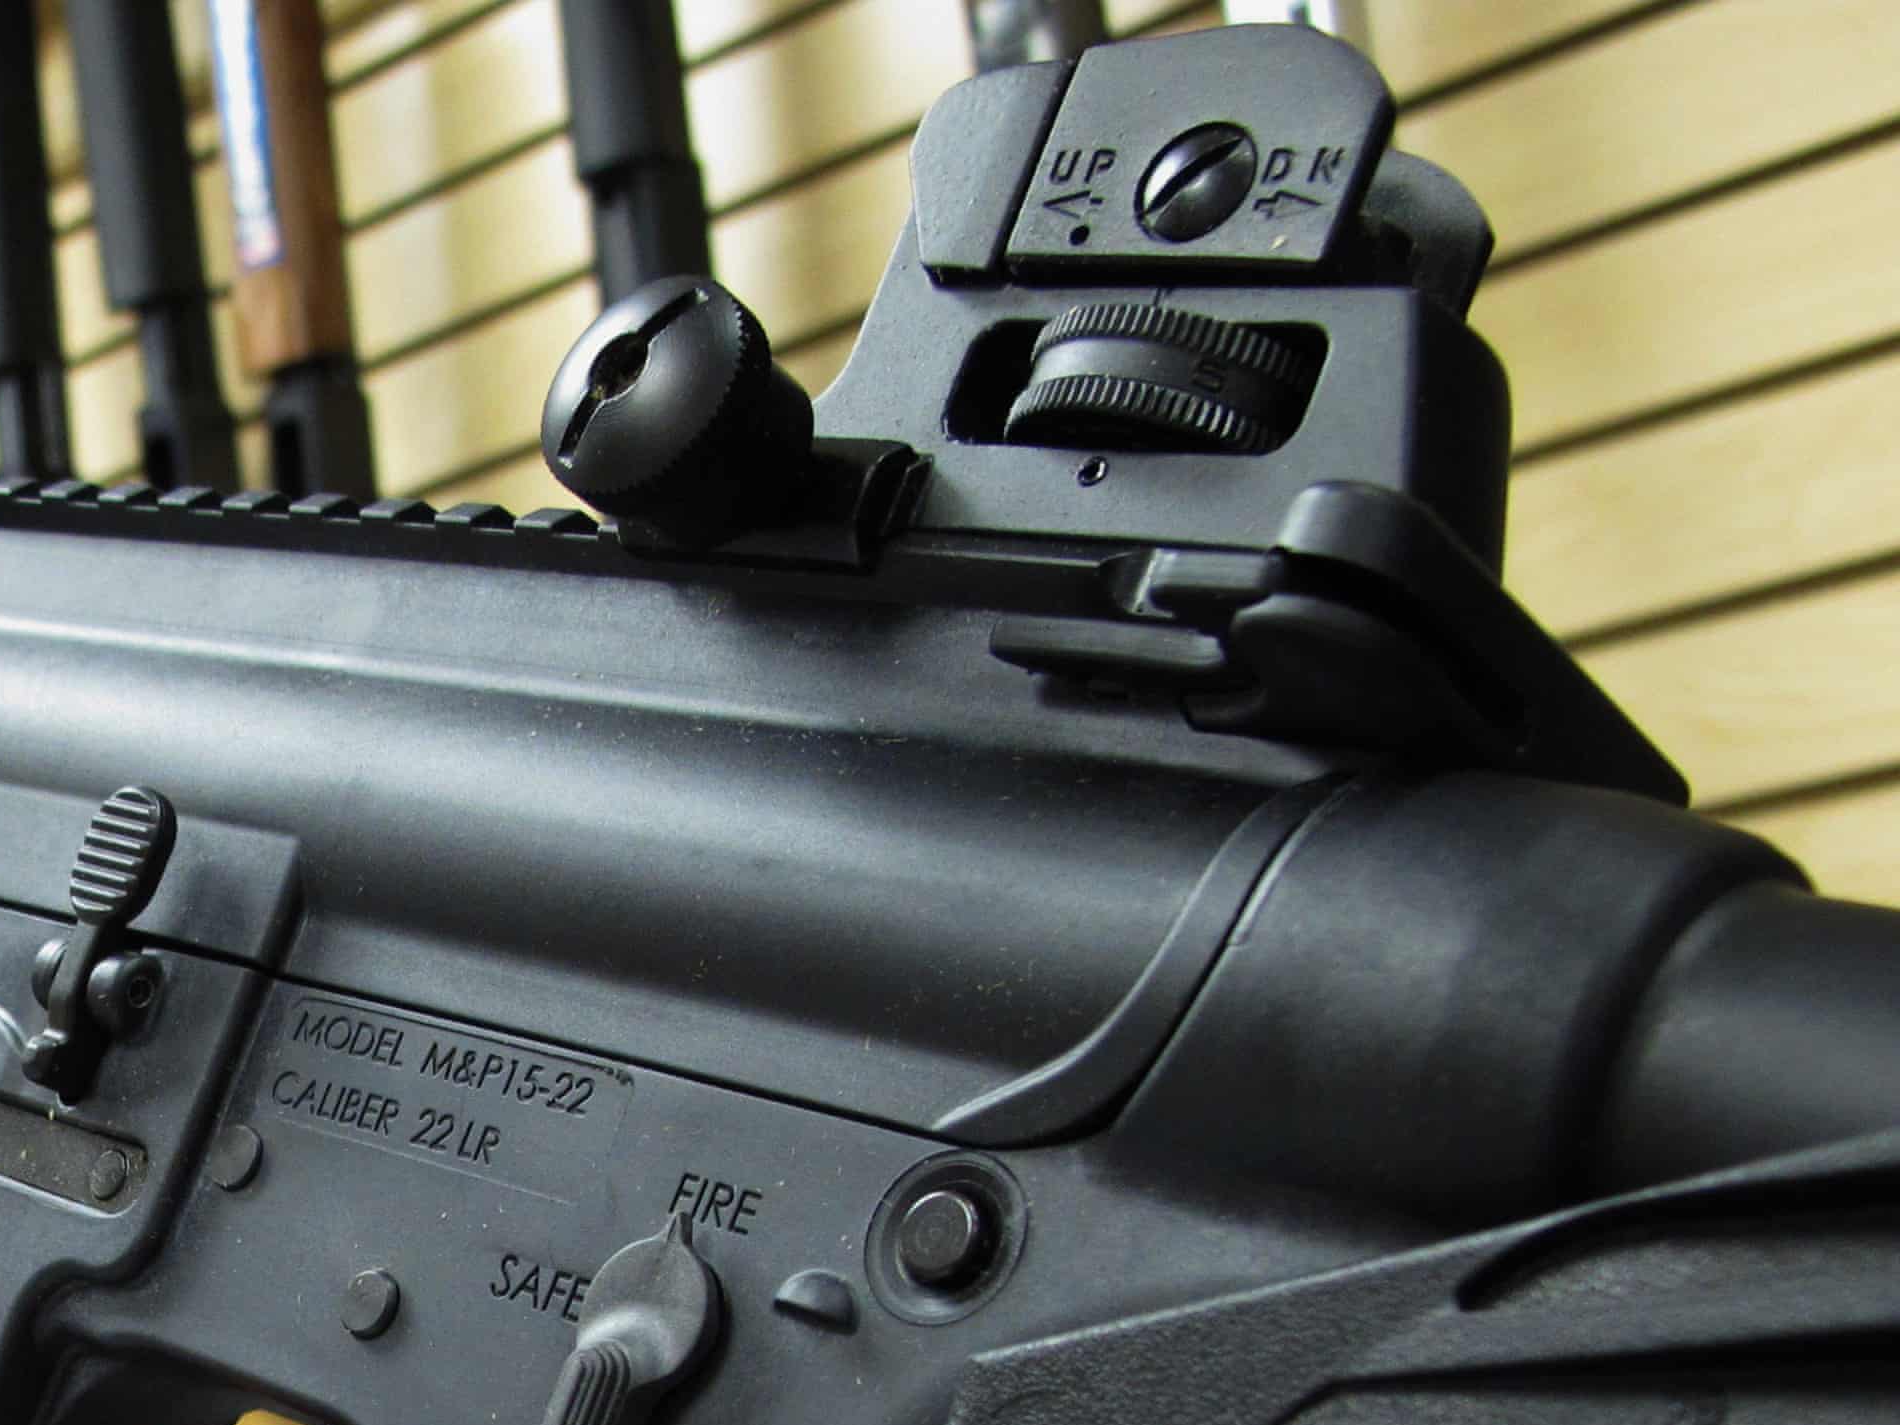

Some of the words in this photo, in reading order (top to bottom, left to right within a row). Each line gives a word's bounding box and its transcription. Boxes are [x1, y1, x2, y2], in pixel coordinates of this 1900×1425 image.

[1049, 148, 1116, 184] UP
[293, 1011, 405, 1066] MODEL
[420, 1042, 595, 1115] M&P15-22
[272, 1070, 399, 1135] CALIBER
[410, 1107, 455, 1151] 22
[458, 1121, 501, 1165] LR
[668, 1172, 763, 1235] FIRE
[490, 1254, 592, 1322] SAFE
